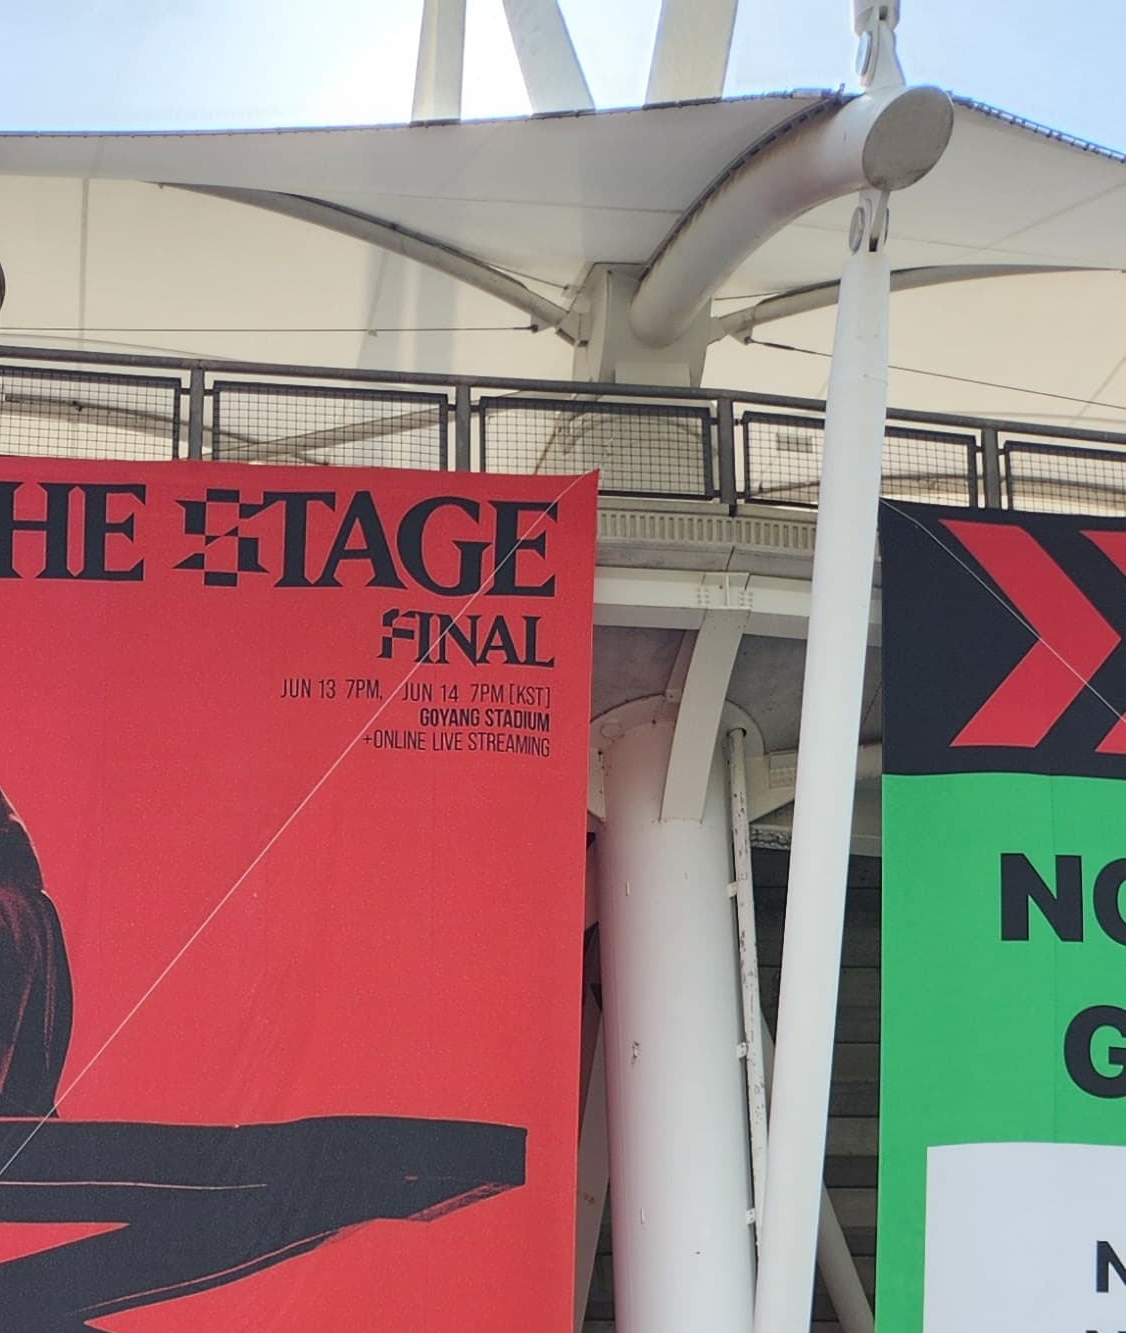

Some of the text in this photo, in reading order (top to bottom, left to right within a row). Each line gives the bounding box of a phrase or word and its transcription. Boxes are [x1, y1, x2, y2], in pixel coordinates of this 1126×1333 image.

[173, 488, 559, 599] STAGE
[376, 608, 555, 668] FINAL
[280, 678, 312, 699] JUN
[318, 679, 336, 699] 13
[401, 682, 433, 702] JUN
[441, 684, 459, 703] 14
[470, 683, 505, 703] 7PM
[419, 707, 551, 732] GOYANG STADIUM
[362, 729, 551, 758] +ONLINE LIVE STREAMING
